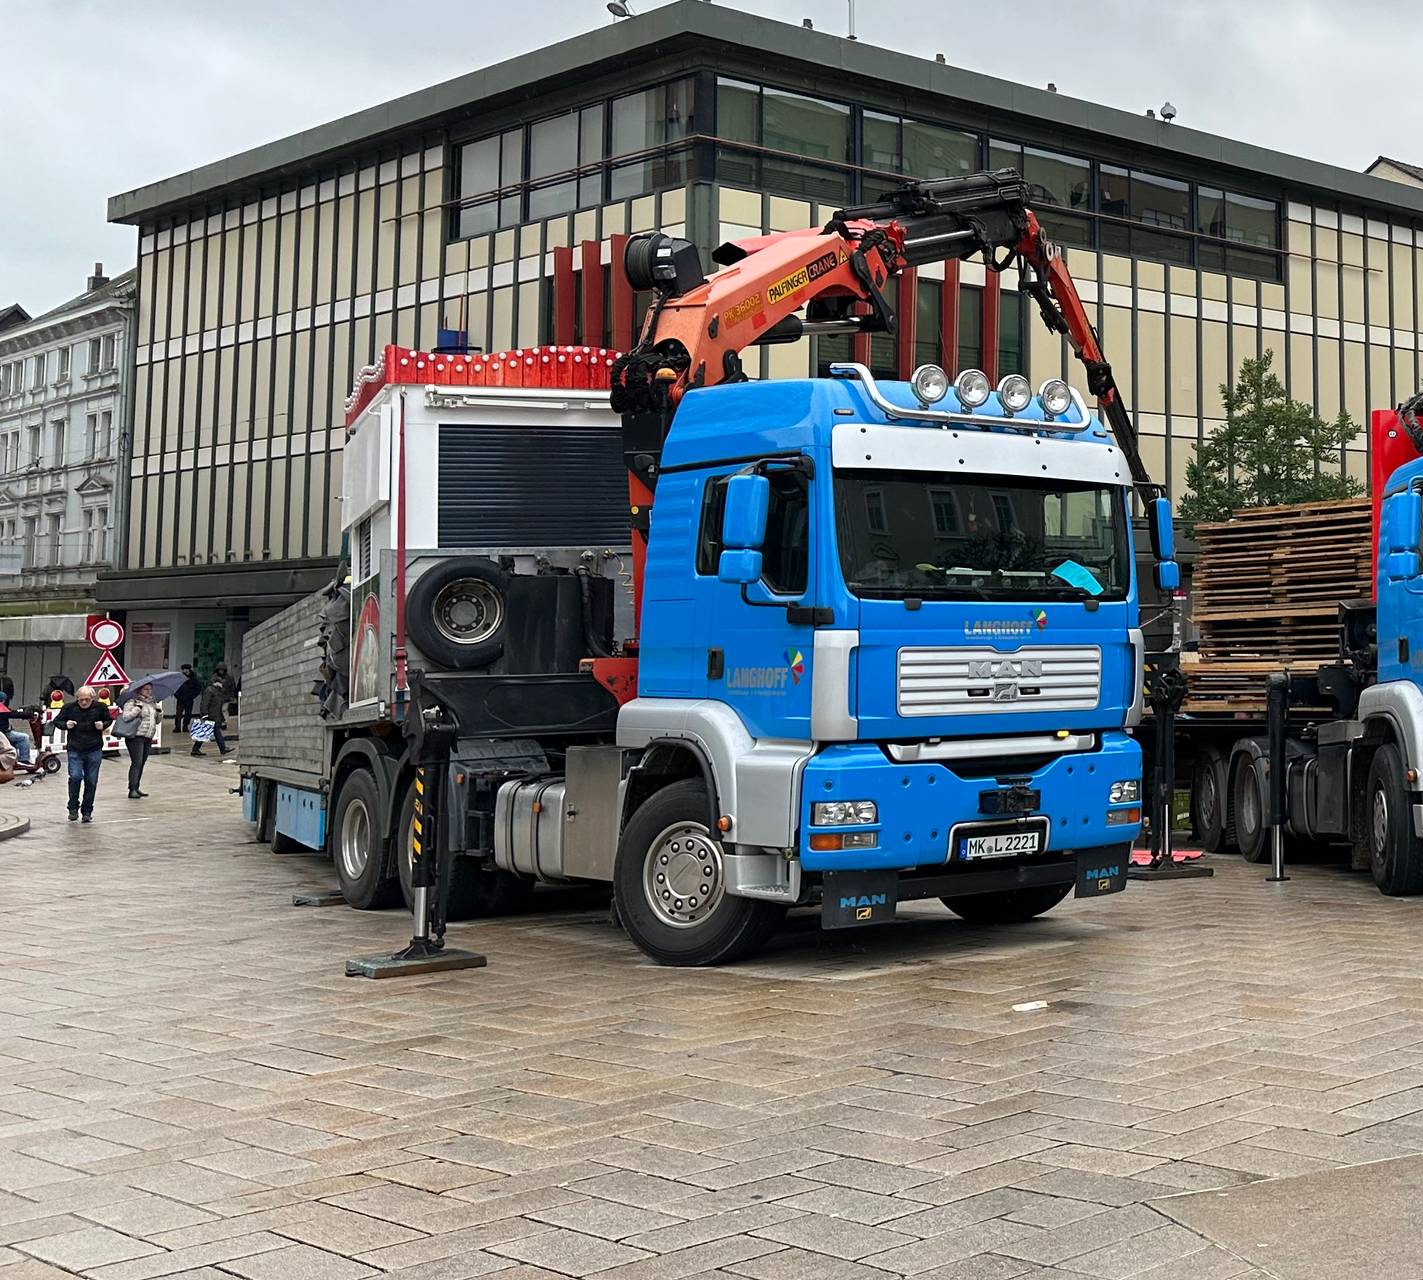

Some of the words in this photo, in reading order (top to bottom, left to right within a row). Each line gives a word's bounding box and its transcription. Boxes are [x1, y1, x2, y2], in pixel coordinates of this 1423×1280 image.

[768, 270, 808, 301] PALFINGER
[808, 253, 836, 279] CRANE
[734, 293, 760, 316] 36002
[963, 620, 1033, 635] LANGHOFF
[726, 667, 788, 688] LANGHOFF
[968, 660, 1042, 678] MAN
[968, 839, 987, 855] MK
[1005, 834, 1037, 851] 2221
[1086, 865, 1120, 880] MAN
[840, 893, 886, 908] MAN
